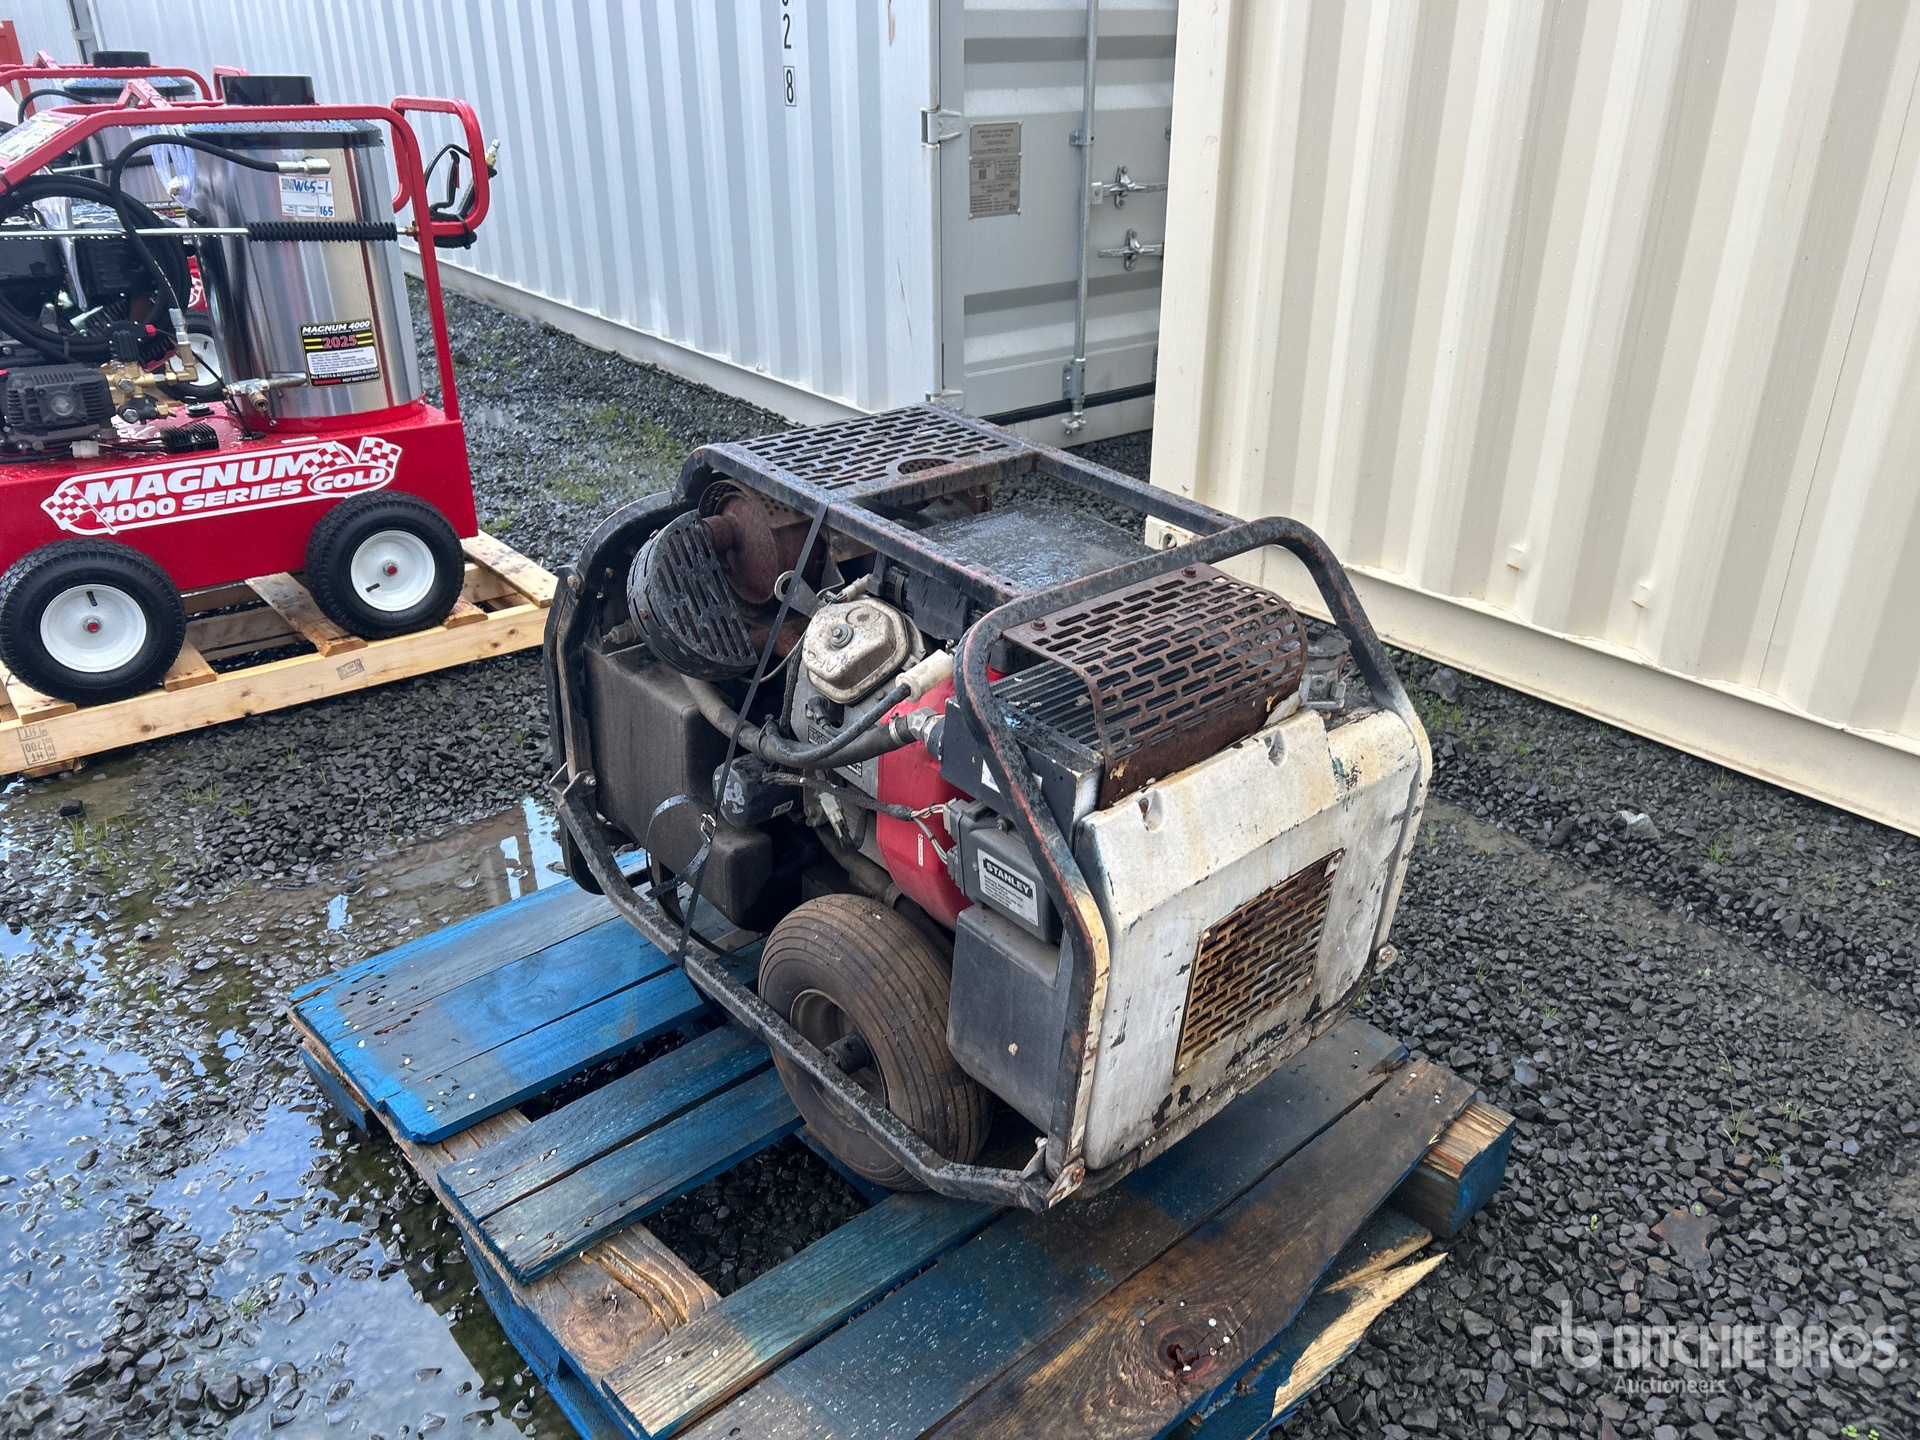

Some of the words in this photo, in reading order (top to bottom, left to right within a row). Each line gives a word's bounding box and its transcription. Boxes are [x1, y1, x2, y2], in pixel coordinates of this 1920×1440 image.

[786, 69, 794, 103] 8
[293, 179, 329, 193] W65-1
[302, 323, 347, 334] MAGNUM
[348, 320, 370, 330] 4000
[322, 334, 358, 349] 2025
[84, 452, 321, 506] MAGNUM
[96, 497, 176, 523] 4000
[181, 479, 303, 511] SERIES
[313, 468, 386, 491] GOLD
[986, 862, 1030, 894] STANLEY
